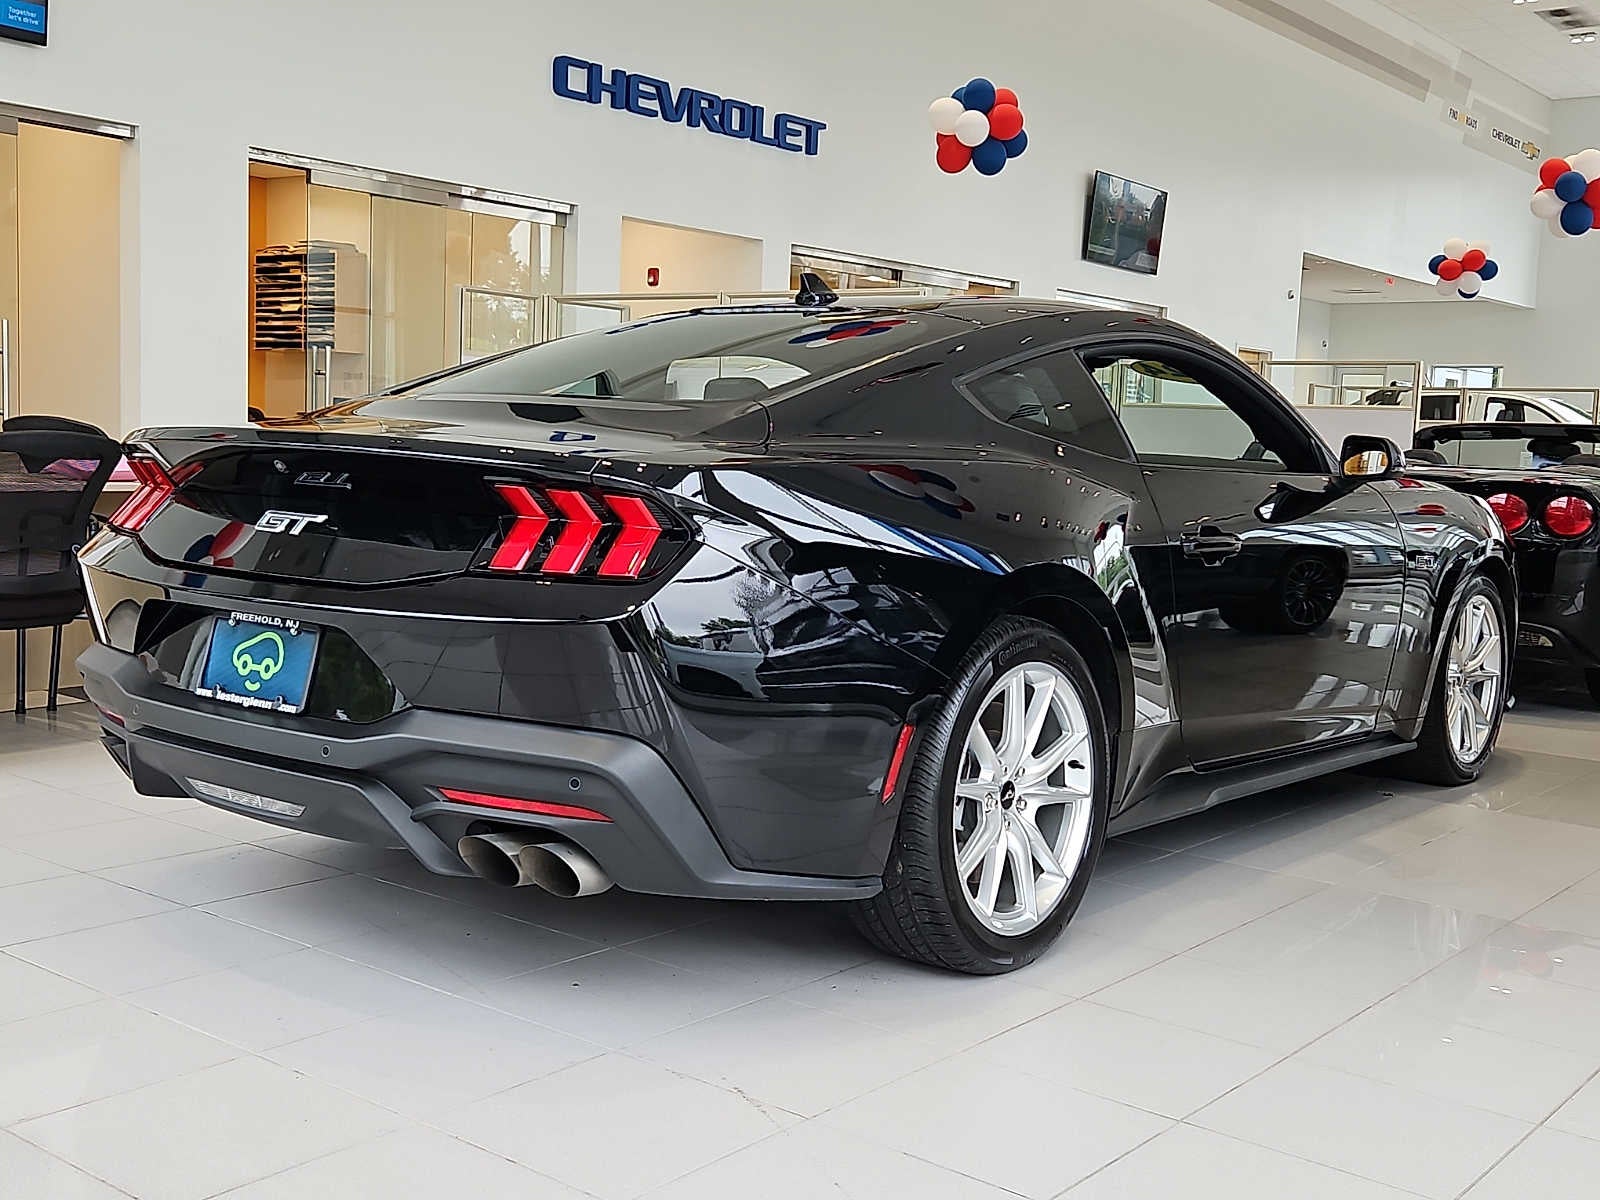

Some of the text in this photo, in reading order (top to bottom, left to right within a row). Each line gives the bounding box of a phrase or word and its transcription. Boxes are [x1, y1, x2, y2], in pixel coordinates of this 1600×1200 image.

[8, 6, 37, 18] Together
[553, 55, 827, 156] CHEVROLET
[1491, 128, 1521, 150] CHEVROLET
[255, 510, 328, 535] GT
[231, 611, 300, 629] FREEHOLD, NJ
[998, 639, 1039, 666] Contintal
